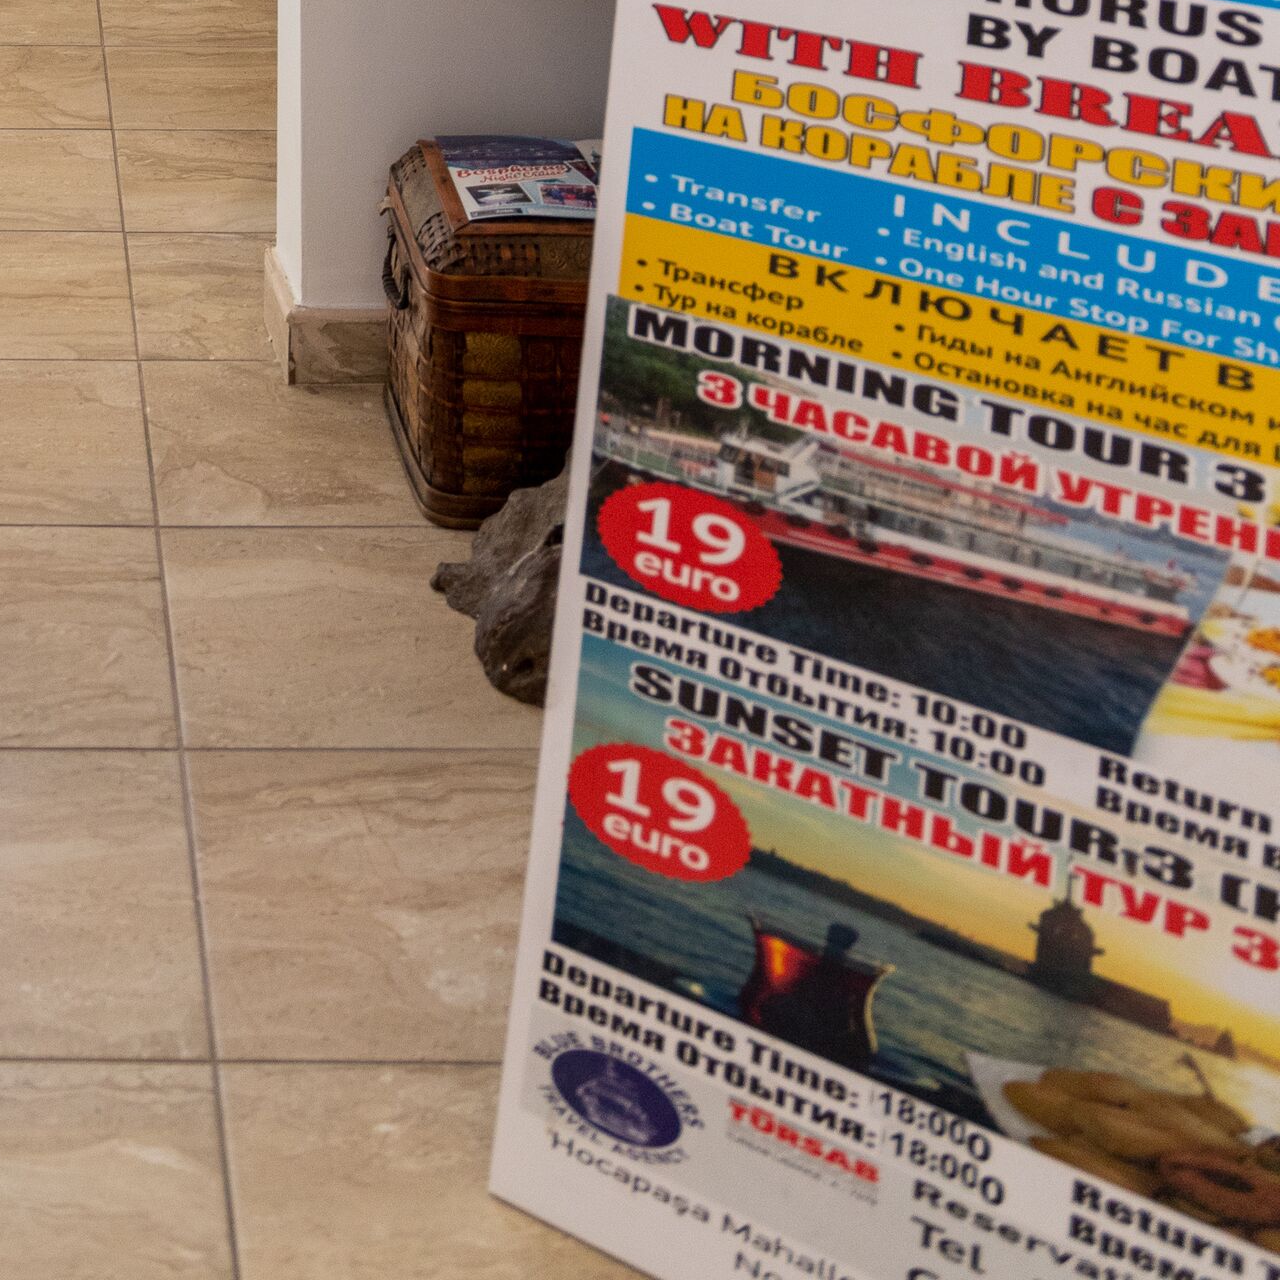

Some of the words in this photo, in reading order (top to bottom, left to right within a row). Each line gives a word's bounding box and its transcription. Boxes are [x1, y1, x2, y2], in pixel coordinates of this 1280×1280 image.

[652, 3, 925, 90] WITH
[955, 60, 1280, 160] BREA
[966, 13, 1062, 59] BY
[663, 93, 747, 143] НА
[760, 113, 1076, 214] КОРАБЛЕ
[671, 174, 822, 223] Transfer
[670, 202, 754, 238] Boat
[765, 224, 848, 260] Tour
[903, 227, 1028, 273] English
[1038, 263, 1105, 291] and
[1116, 277, 1261, 328] Russian
[653, 283, 697, 309] Тур
[705, 300, 738, 320] на
[746, 311, 863, 352] корабле
[657, 258, 805, 311] Трансфер
[769, 253, 1185, 373] ВКЛЮЧАЕТ
[899, 257, 965, 288] One
[975, 274, 1059, 310] Hour
[1069, 297, 1150, 334] Stop
[1161, 318, 1222, 350] For
[633, 307, 959, 422] MORNING
[981, 398, 1190, 485] TOUR
[1215, 462, 1266, 504] 3
[913, 352, 1075, 409] Остановка
[1087, 401, 1124, 422] на
[1135, 413, 1188, 439] час
[1198, 429, 1262, 458] для
[918, 324, 994, 358] Гиды
[1005, 351, 1041, 371] на
[1050, 359, 1255, 426] Английском
[752, 385, 1039, 492] ЧАСАВОЙ
[634, 551, 740, 602] euro
[635, 497, 746, 566] 19
[582, 608, 709, 671] Время
[719, 655, 919, 745] Отбытия:
[929, 729, 1046, 787] 10:00
[586, 582, 778, 665] Departure
[789, 650, 901, 709] Time:
[912, 692, 1027, 749] 10:00
[605, 758, 717, 833] 19
[632, 664, 898, 781] SUNSET
[914, 762, 1120, 867] TOUR
[1098, 755, 1272, 835] Return
[602, 813, 710, 872] euro
[667, 719, 1053, 888] ЗАКАТНЫЙ
[1073, 866, 1210, 938] ТУР
[1096, 786, 1250, 860] Время
[537, 977, 666, 1055] Время
[677, 1040, 877, 1149] Отбытия:
[542, 949, 736, 1053] Departure
[747, 1038, 859, 1109] Time:
[910, 1214, 986, 1275] Tel
[1069, 1213, 1210, 1280] Врем
[1073, 1180, 1245, 1275] Return
